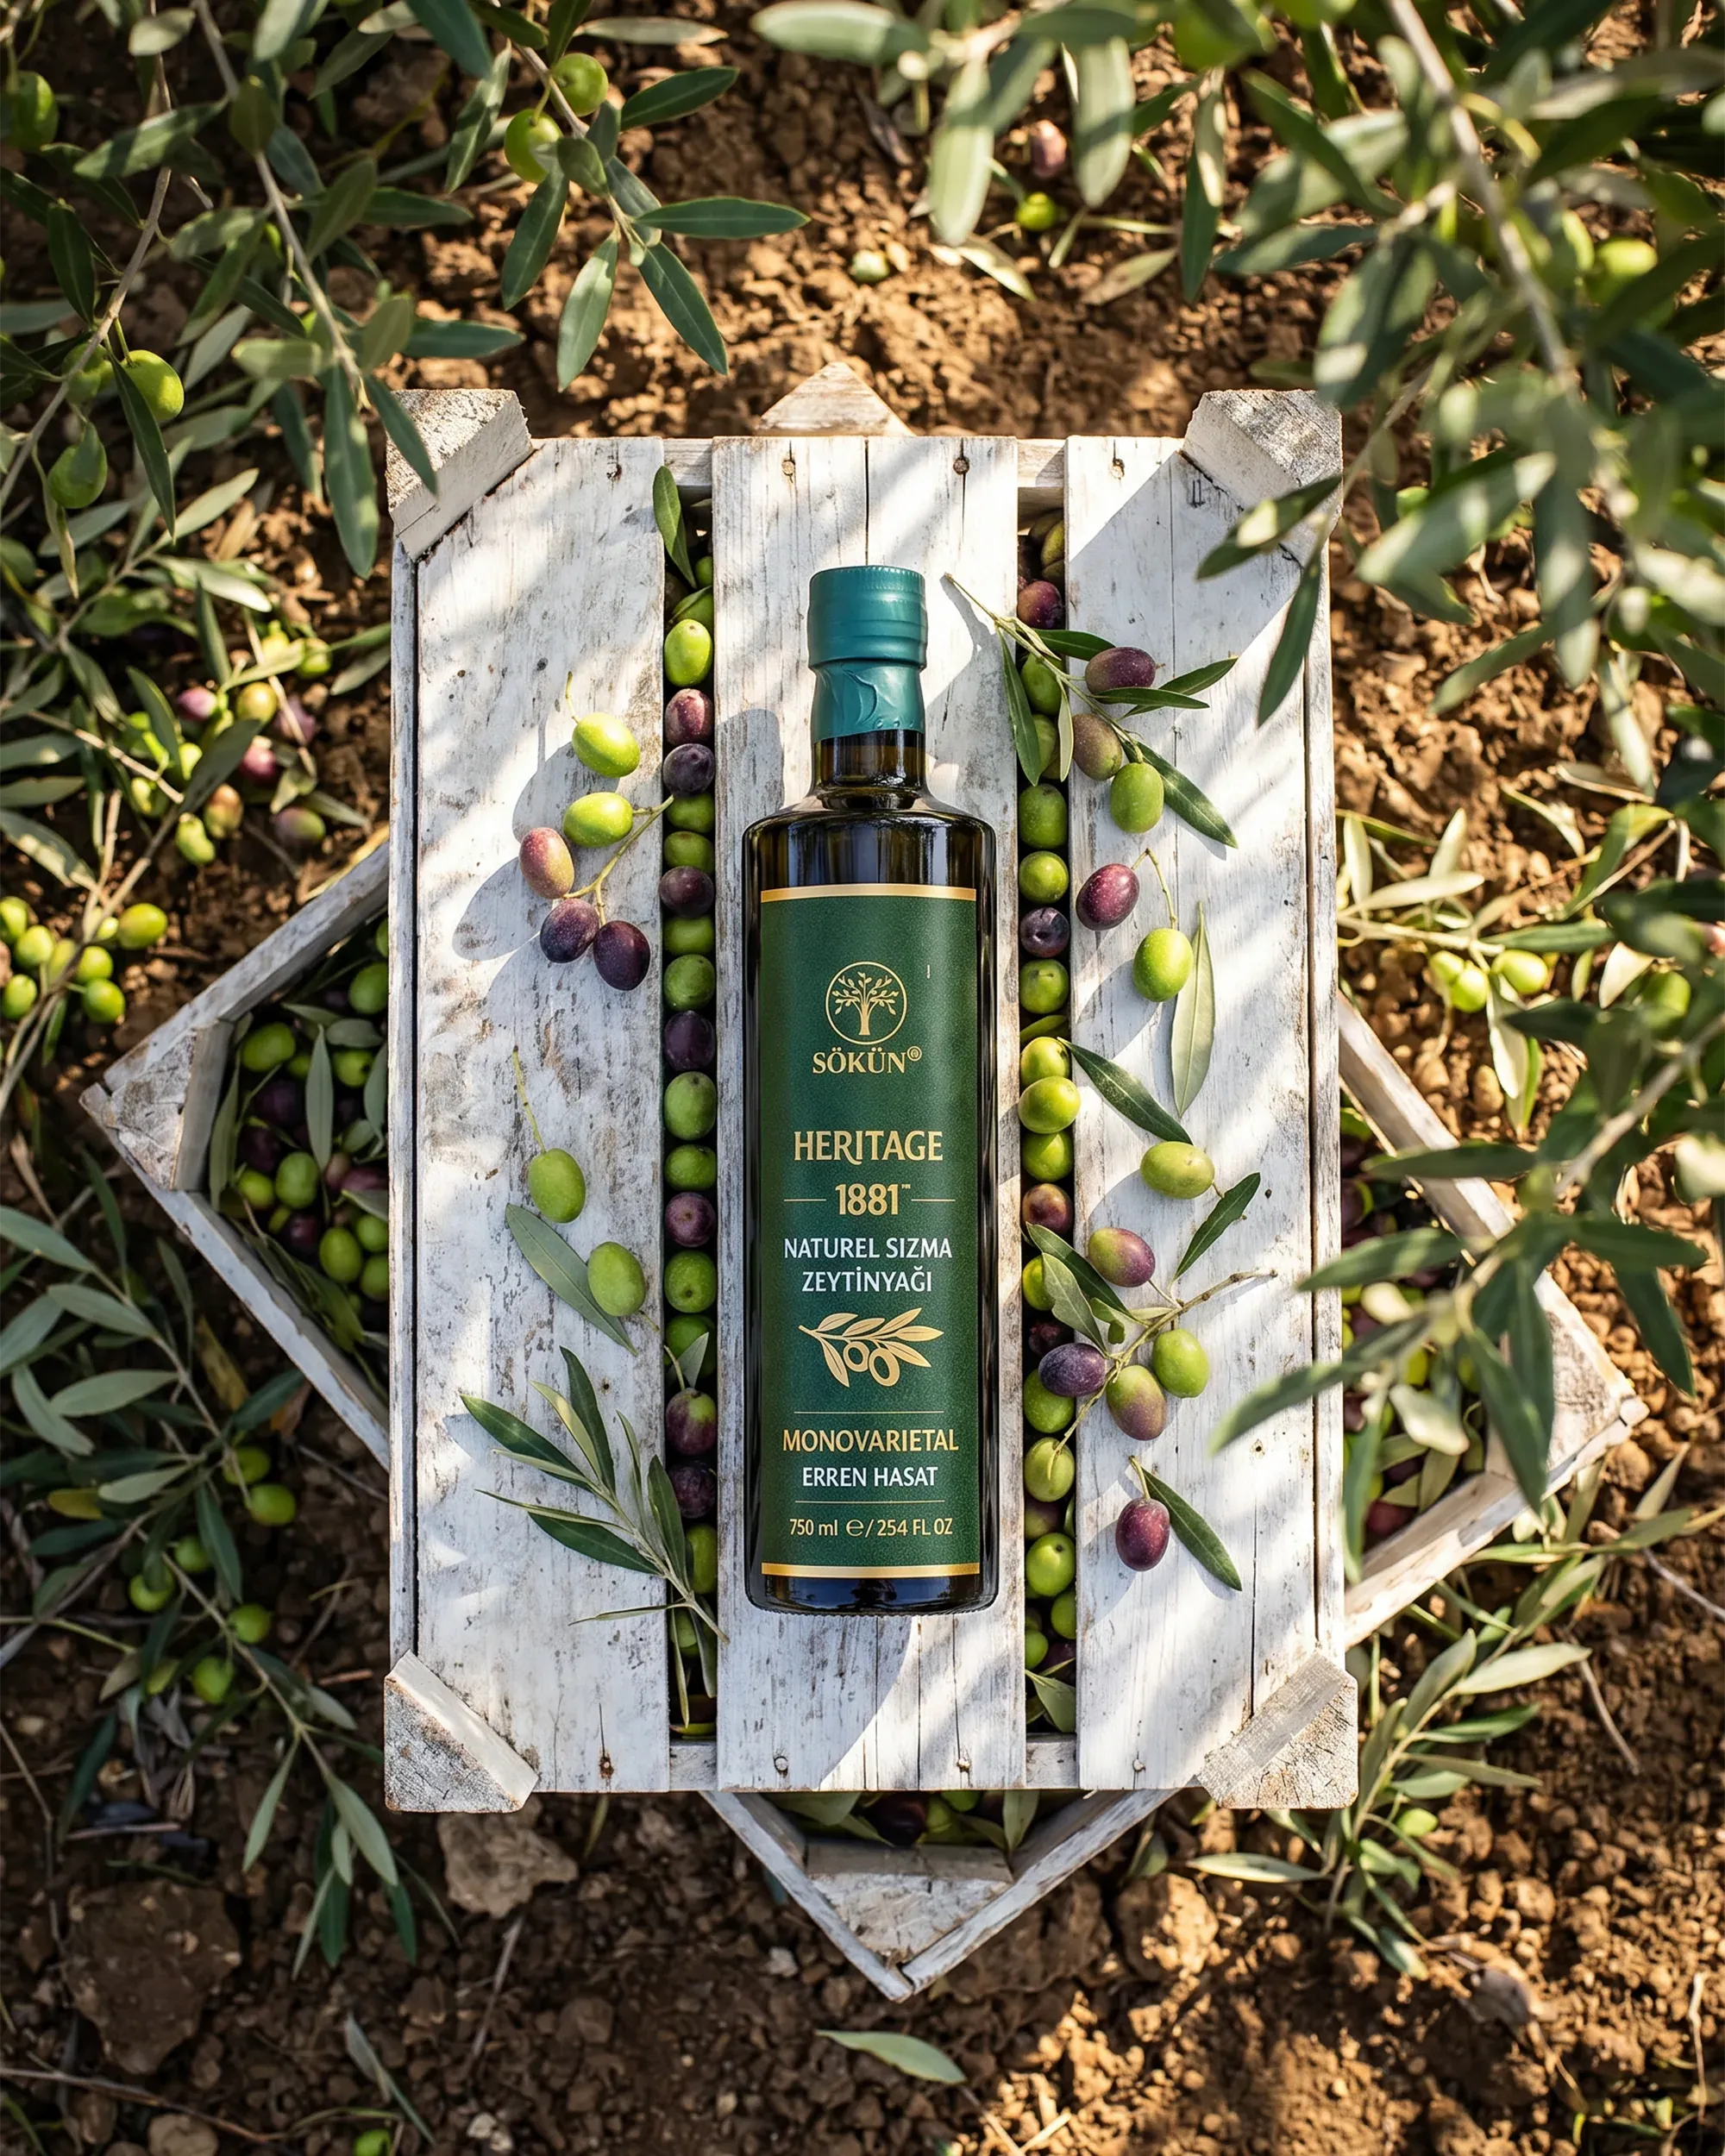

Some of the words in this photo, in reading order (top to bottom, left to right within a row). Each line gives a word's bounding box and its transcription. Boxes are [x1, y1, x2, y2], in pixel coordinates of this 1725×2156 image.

[794, 1130, 944, 1165] HERITAGE
[835, 1183, 899, 1216] 1881
[784, 1238, 880, 1258] NATUREL
[886, 1238, 953, 1259] SIZMA
[801, 1265, 932, 1292] ZEYTİNYAĞI
[782, 1428, 959, 1452] MONOVARIETAL
[802, 1467, 867, 1487] ERREN
[874, 1467, 938, 1487] HASAT
[789, 1519, 814, 1535] 750
[819, 1520, 838, 1536] ml
[913, 1519, 932, 1535] FL
[933, 1518, 953, 1535] OZ
